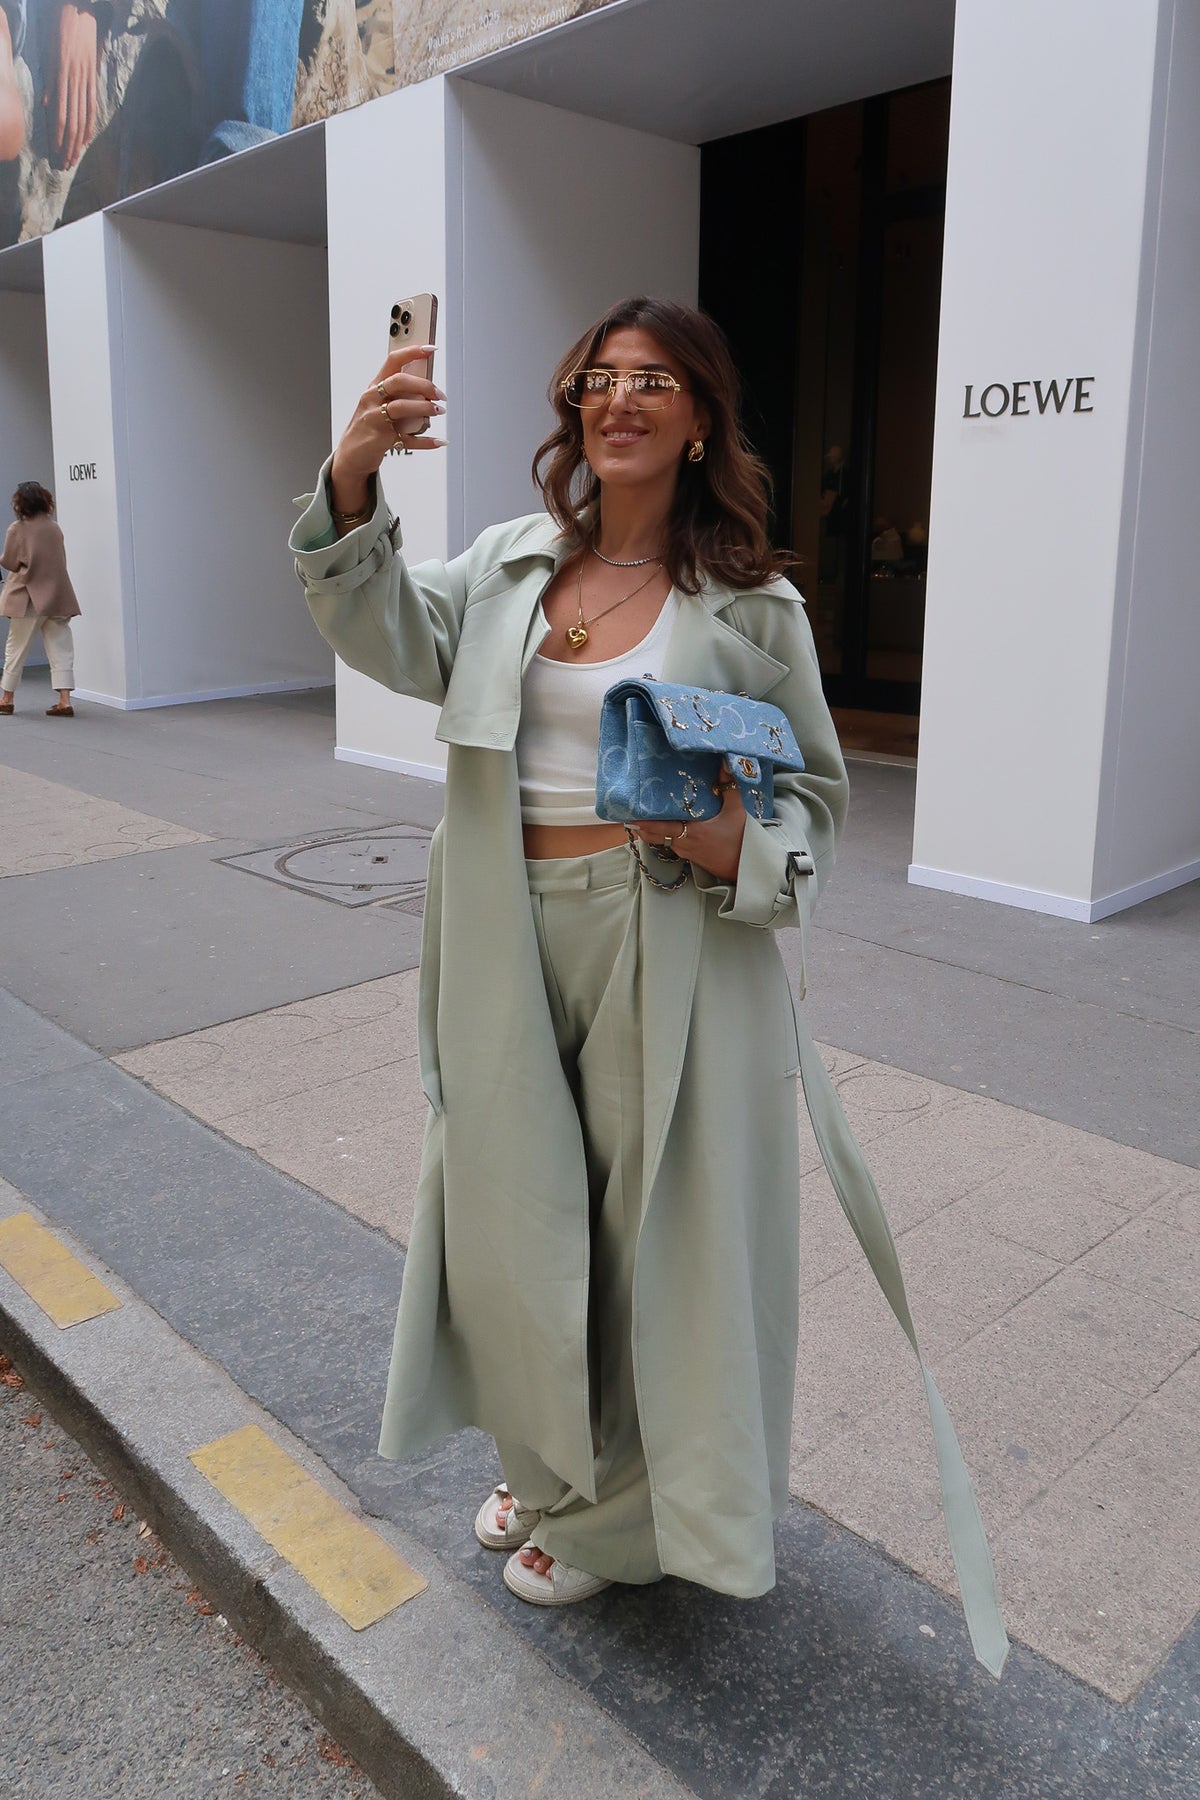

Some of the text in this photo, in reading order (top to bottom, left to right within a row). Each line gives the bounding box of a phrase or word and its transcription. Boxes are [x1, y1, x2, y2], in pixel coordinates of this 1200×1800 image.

[480, 10, 500, 30] 2025
[490, 32, 504, 49] par
[506, 22, 528, 39] Gray
[530, 6, 568, 30] Sorrenti
[963, 377, 1095, 418] LOEWE
[69, 463, 97, 481] LOEWE
